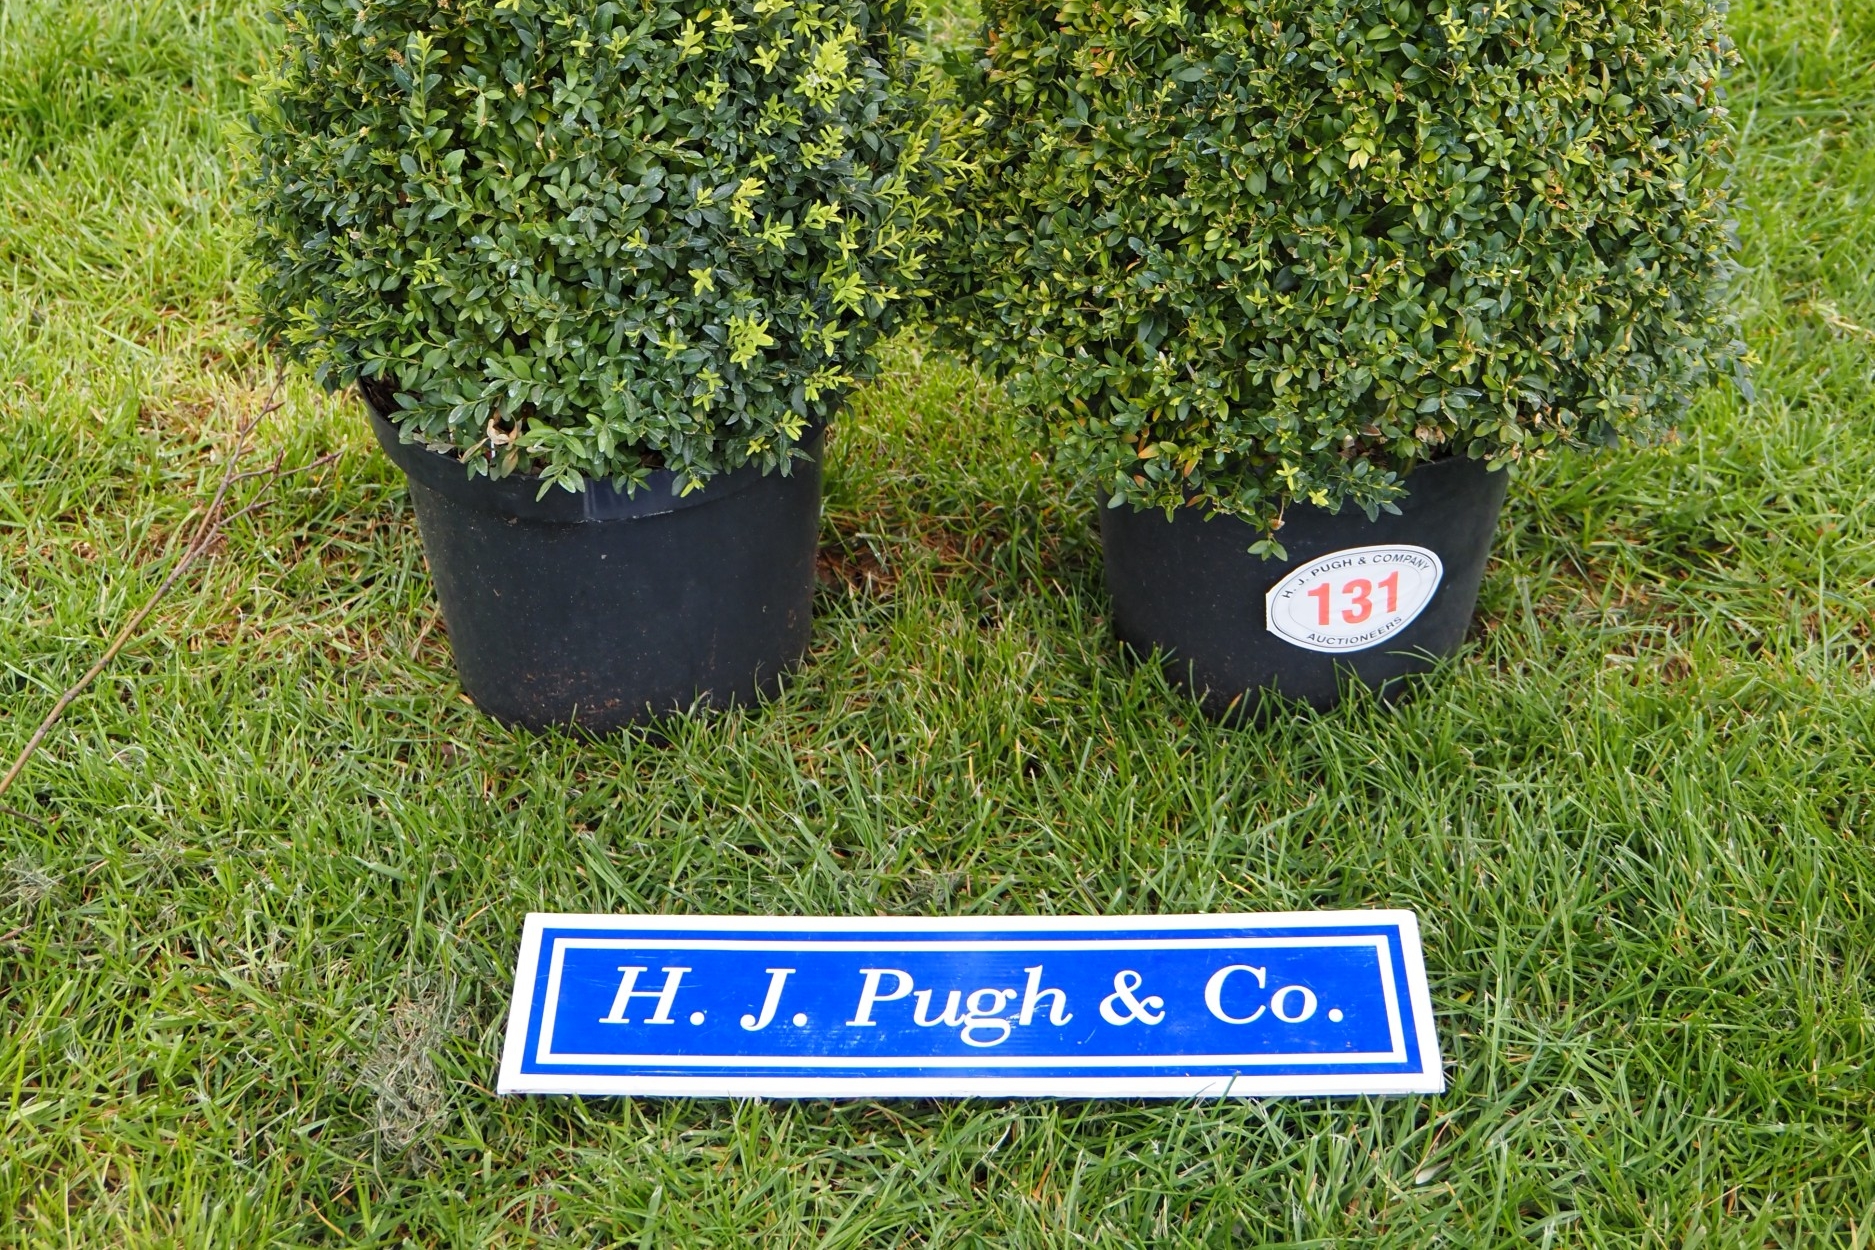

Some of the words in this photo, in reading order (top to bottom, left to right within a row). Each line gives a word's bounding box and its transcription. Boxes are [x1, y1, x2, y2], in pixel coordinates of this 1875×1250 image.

[1311, 558, 1352, 576] PUGH
[1357, 556, 1367, 565] &
[1372, 554, 1430, 571] COMPANY
[1307, 570, 1399, 626] 131
[1307, 616, 1402, 645] AUCTIONEERS
[598, 965, 706, 1027] H.
[739, 967, 808, 1032] J.
[845, 964, 1073, 1048] Pugh
[1099, 969, 1166, 1027] &
[1204, 964, 1345, 1025] Co.
